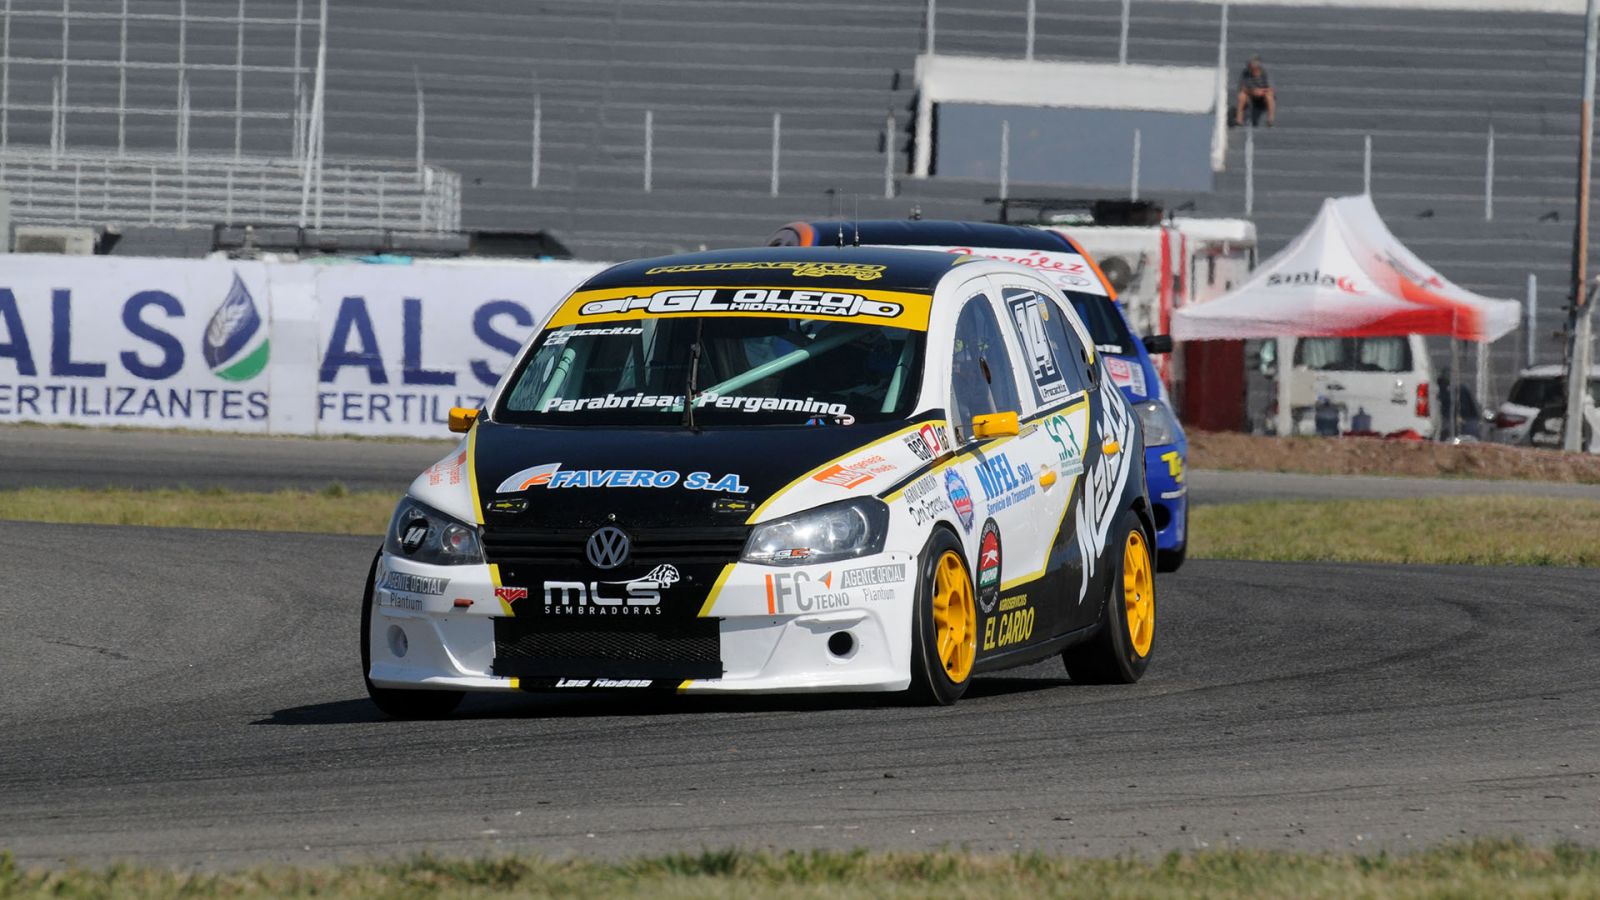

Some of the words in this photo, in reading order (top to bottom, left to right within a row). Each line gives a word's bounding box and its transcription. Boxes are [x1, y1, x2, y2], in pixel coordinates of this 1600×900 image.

[729, 303, 849, 316] HIDRAULICA
[733, 289, 854, 308] OLEO
[319, 297, 535, 387] ALS
[541, 392, 685, 413] Parabrisas
[696, 392, 848, 416] Pergamino
[546, 470, 680, 490] FAVERO
[683, 474, 750, 494] S.A.
[845, 569, 877, 588] AGENTE
[876, 565, 905, 585] OFICIAL
[544, 581, 661, 606] MLS
[814, 592, 850, 610] TECNO
[545, 606, 662, 615] SEMBRADORAS
[984, 616, 997, 651] EL
[997, 607, 1035, 648] CARDO
